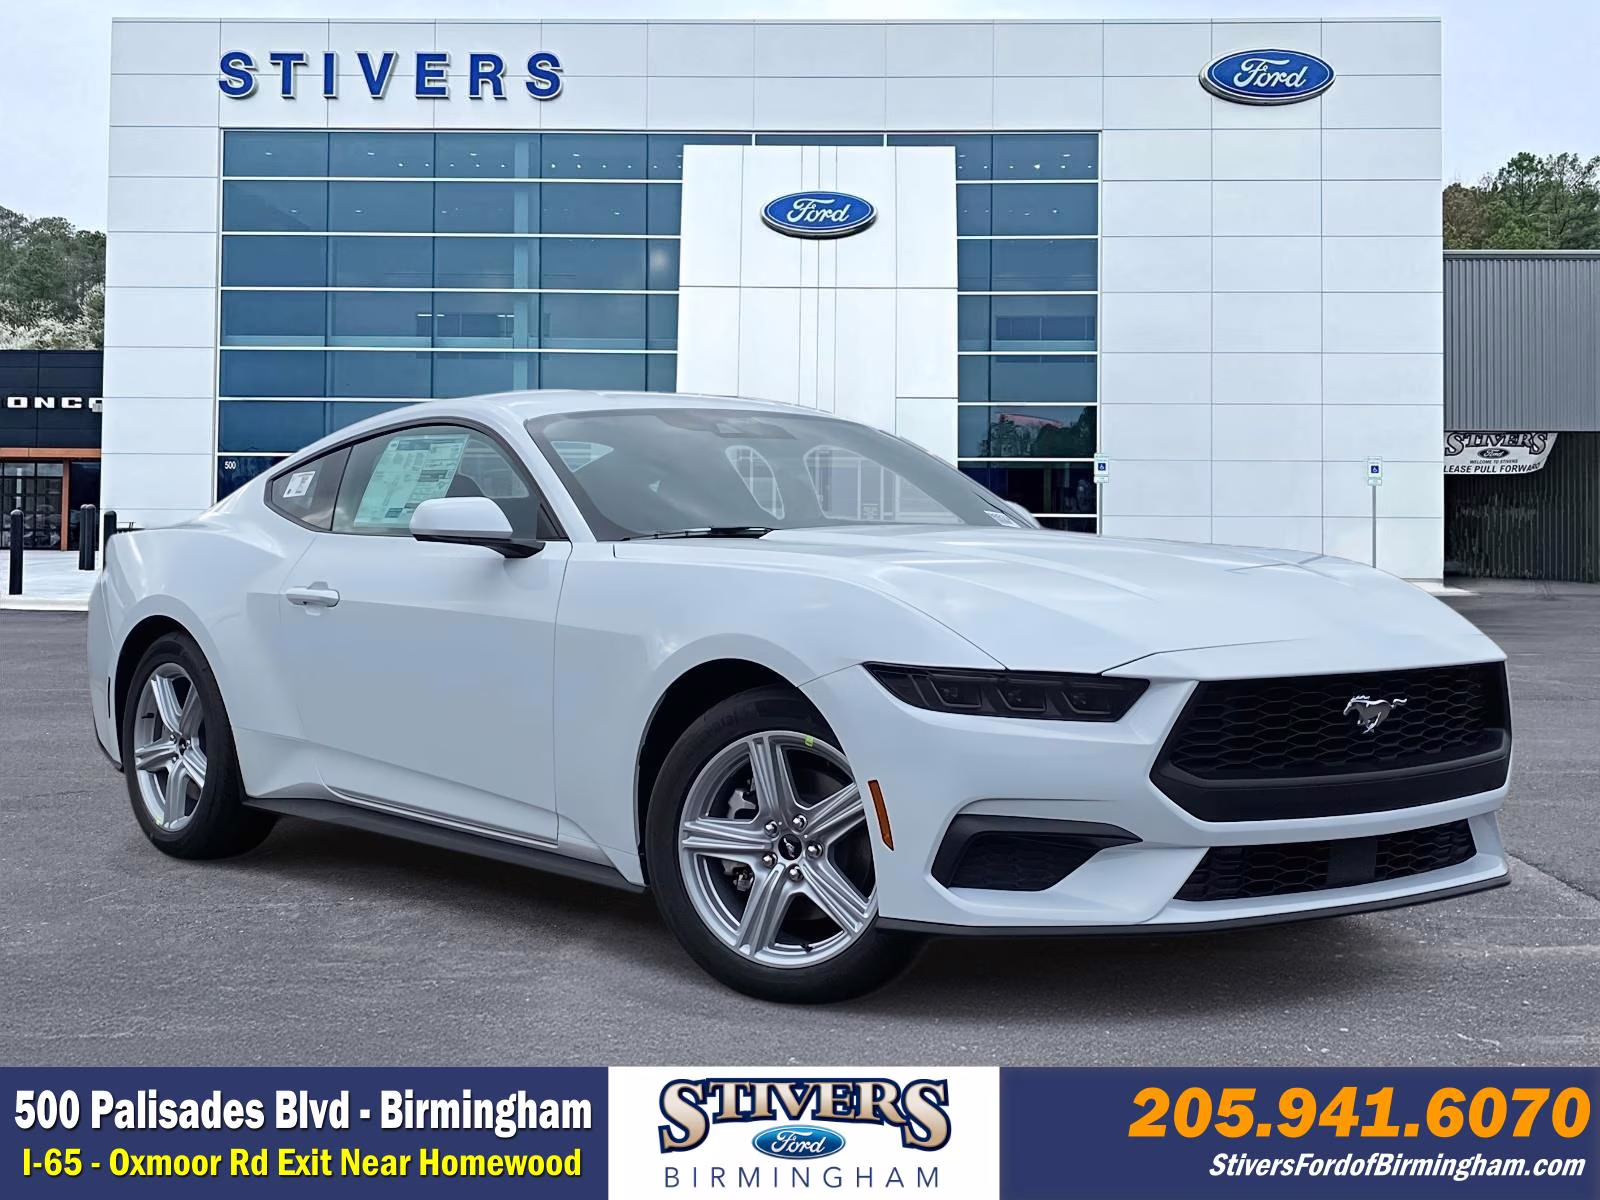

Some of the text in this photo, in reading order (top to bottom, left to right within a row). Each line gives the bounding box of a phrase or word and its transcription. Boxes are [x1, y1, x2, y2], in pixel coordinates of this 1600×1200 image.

[218, 51, 564, 100] STIVERS
[1233, 57, 1309, 88] Ford
[786, 197, 851, 223] Ford
[1444, 432, 1549, 456] STIVERS
[224, 461, 237, 470] 500
[1474, 465, 1497, 473] PULL
[1499, 462, 1541, 473] FORWARD
